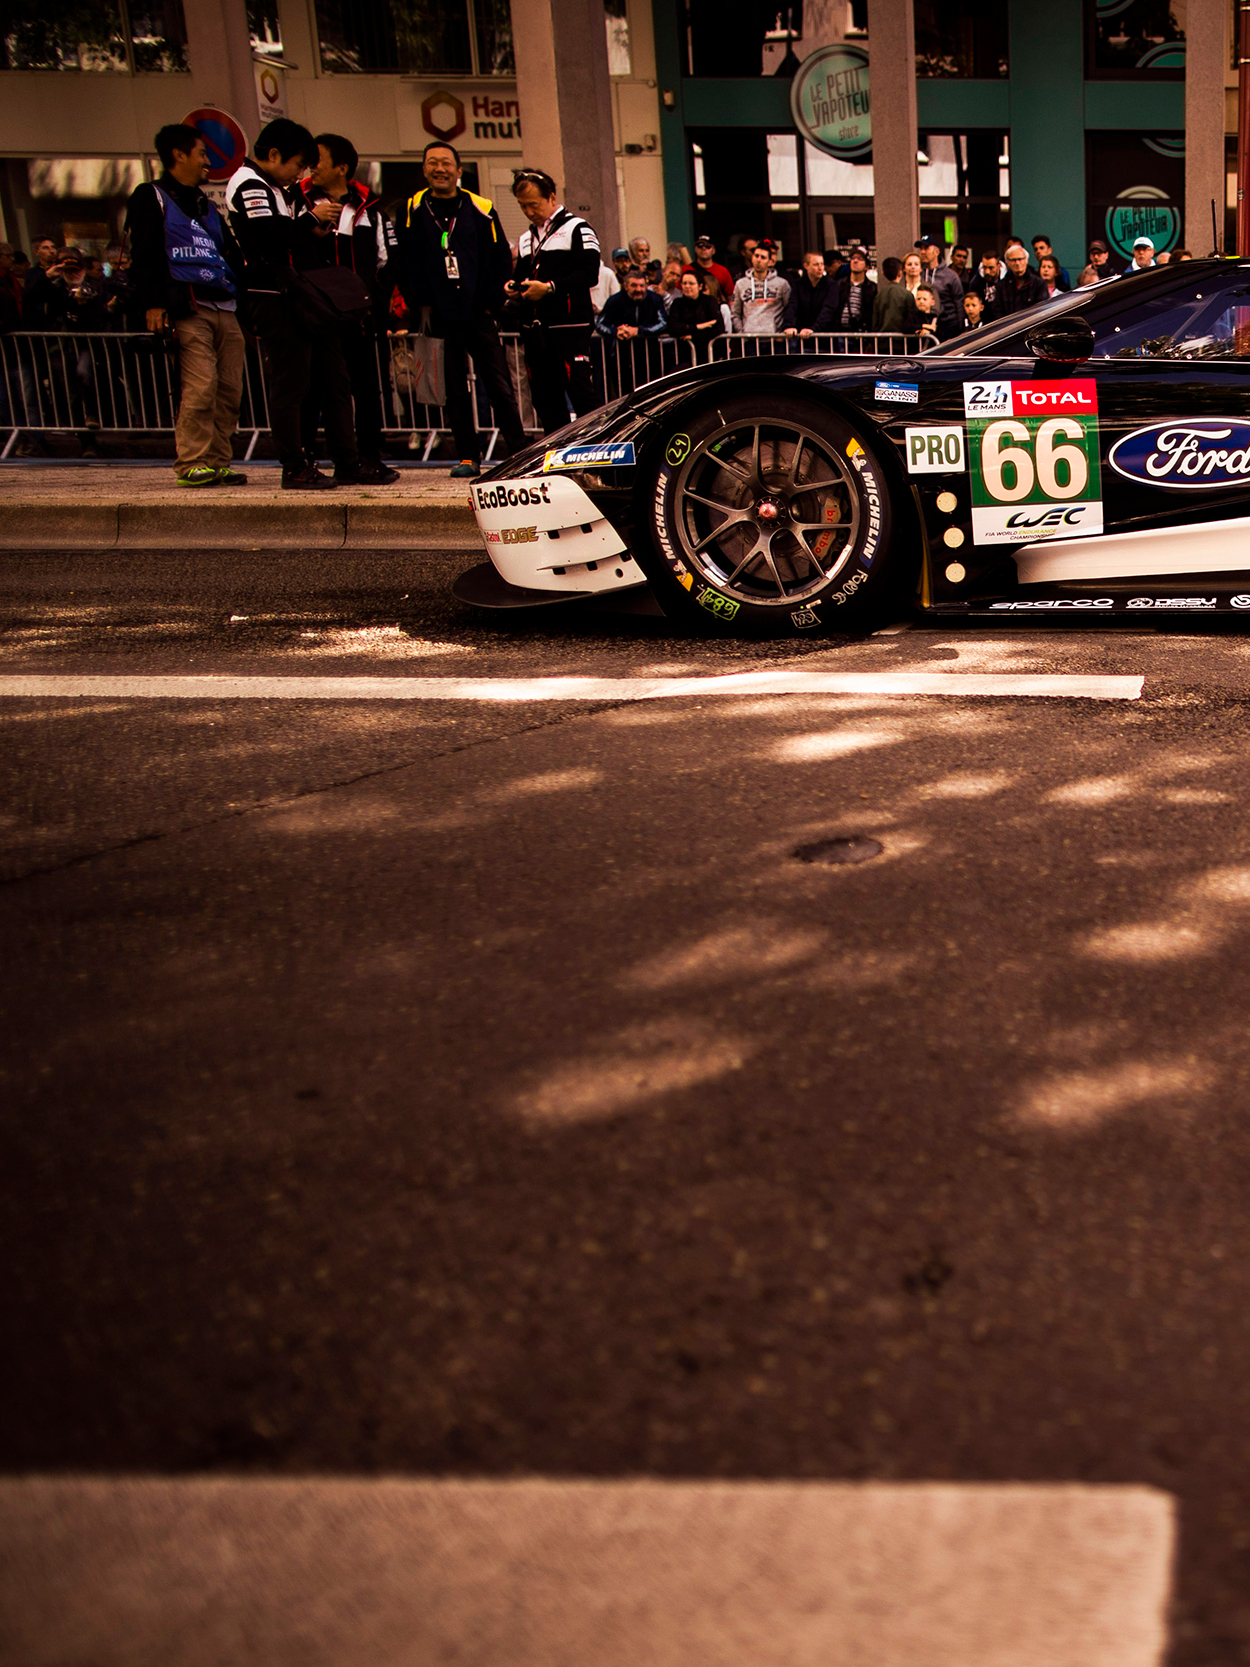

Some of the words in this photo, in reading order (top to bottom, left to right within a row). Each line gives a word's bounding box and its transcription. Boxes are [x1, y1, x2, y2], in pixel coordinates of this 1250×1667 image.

[809, 83, 823, 102] LE
[565, 450, 626, 463] MICHELIN
[668, 438, 687, 458] 29
[910, 434, 961, 466] PRO
[979, 417, 1090, 503] 66
[477, 482, 551, 509] EcoBoost
[655, 472, 676, 560] MICHELIN
[861, 471, 881, 560] MICHELIN
[1005, 507, 1086, 528] WEC
[501, 526, 539, 544] EDGE
[814, 509, 836, 555] brmbo
[989, 598, 1114, 609] sparco
